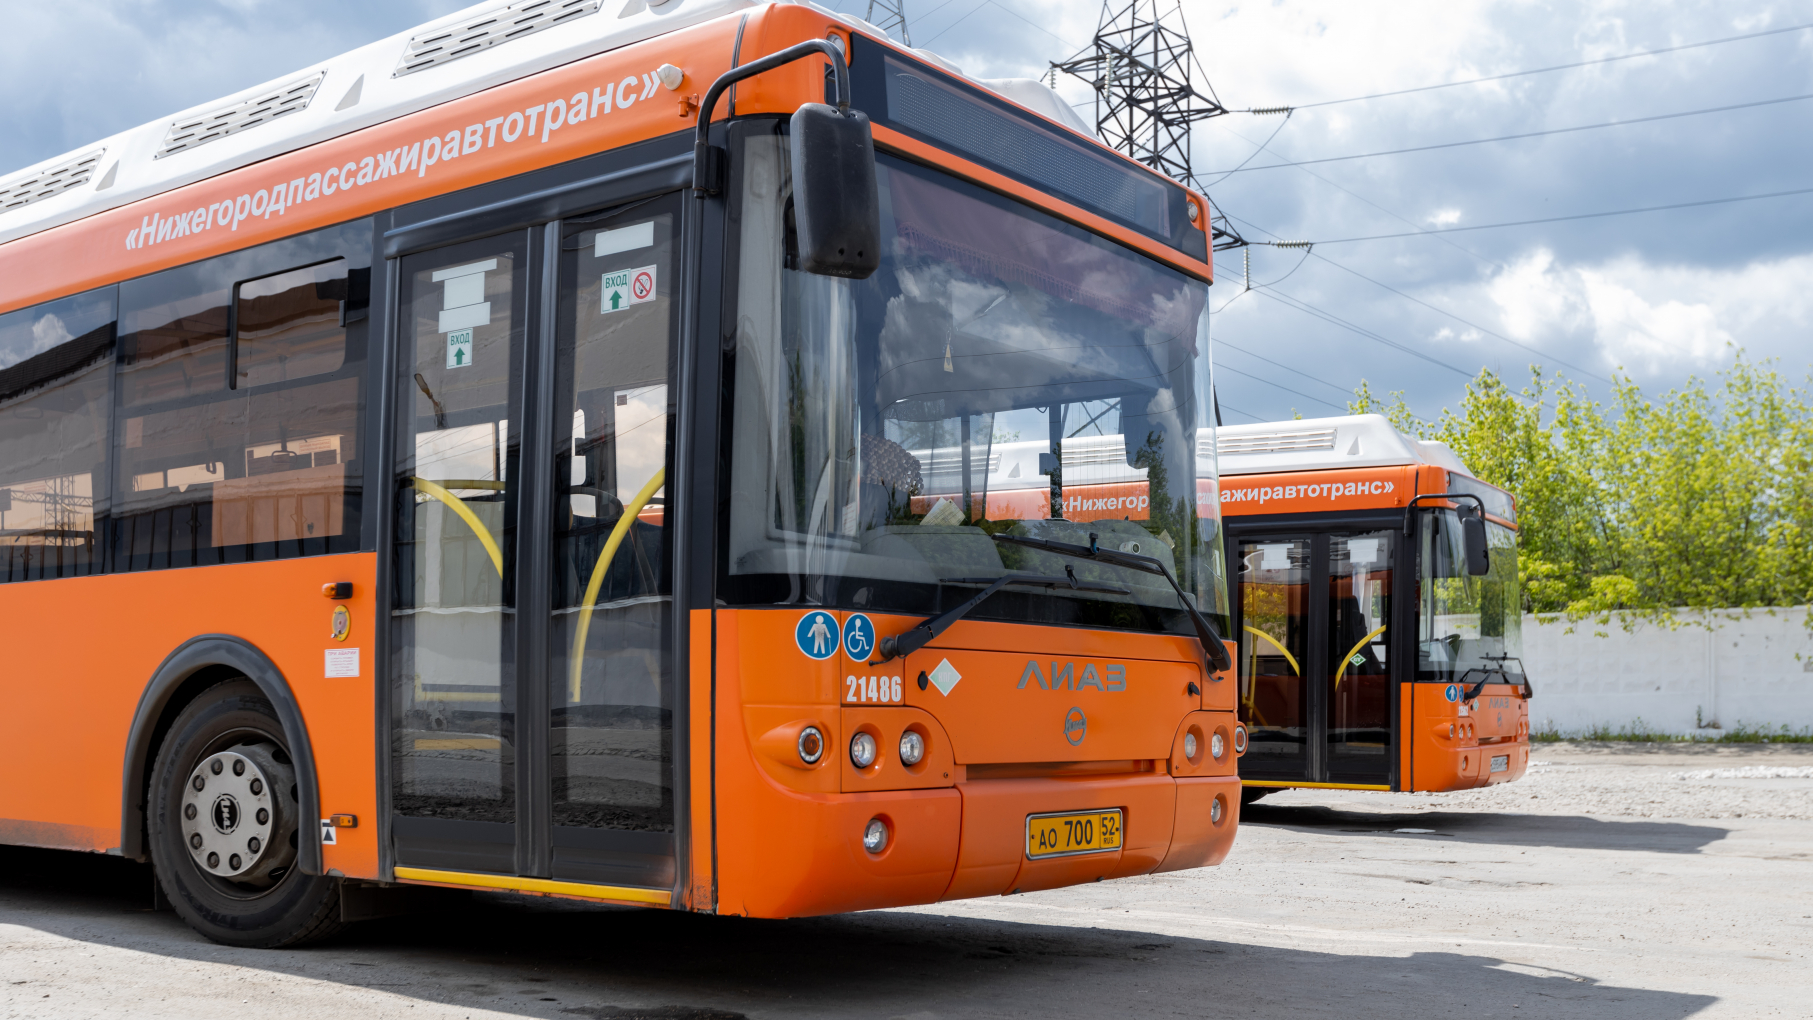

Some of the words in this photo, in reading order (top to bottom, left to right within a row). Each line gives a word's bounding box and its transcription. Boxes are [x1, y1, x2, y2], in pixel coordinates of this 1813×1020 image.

[125, 70, 661, 250] «Нижегородпассажиравтотранс»
[605, 273, 628, 289] ВХОД
[450, 332, 470, 346] ВХОД
[846, 675, 902, 702] 21486
[1016, 660, 1127, 692] ЛИАЗ
[1038, 828, 1057, 850] АО
[1064, 819, 1093, 847] 700
[1101, 816, 1115, 836] 52
